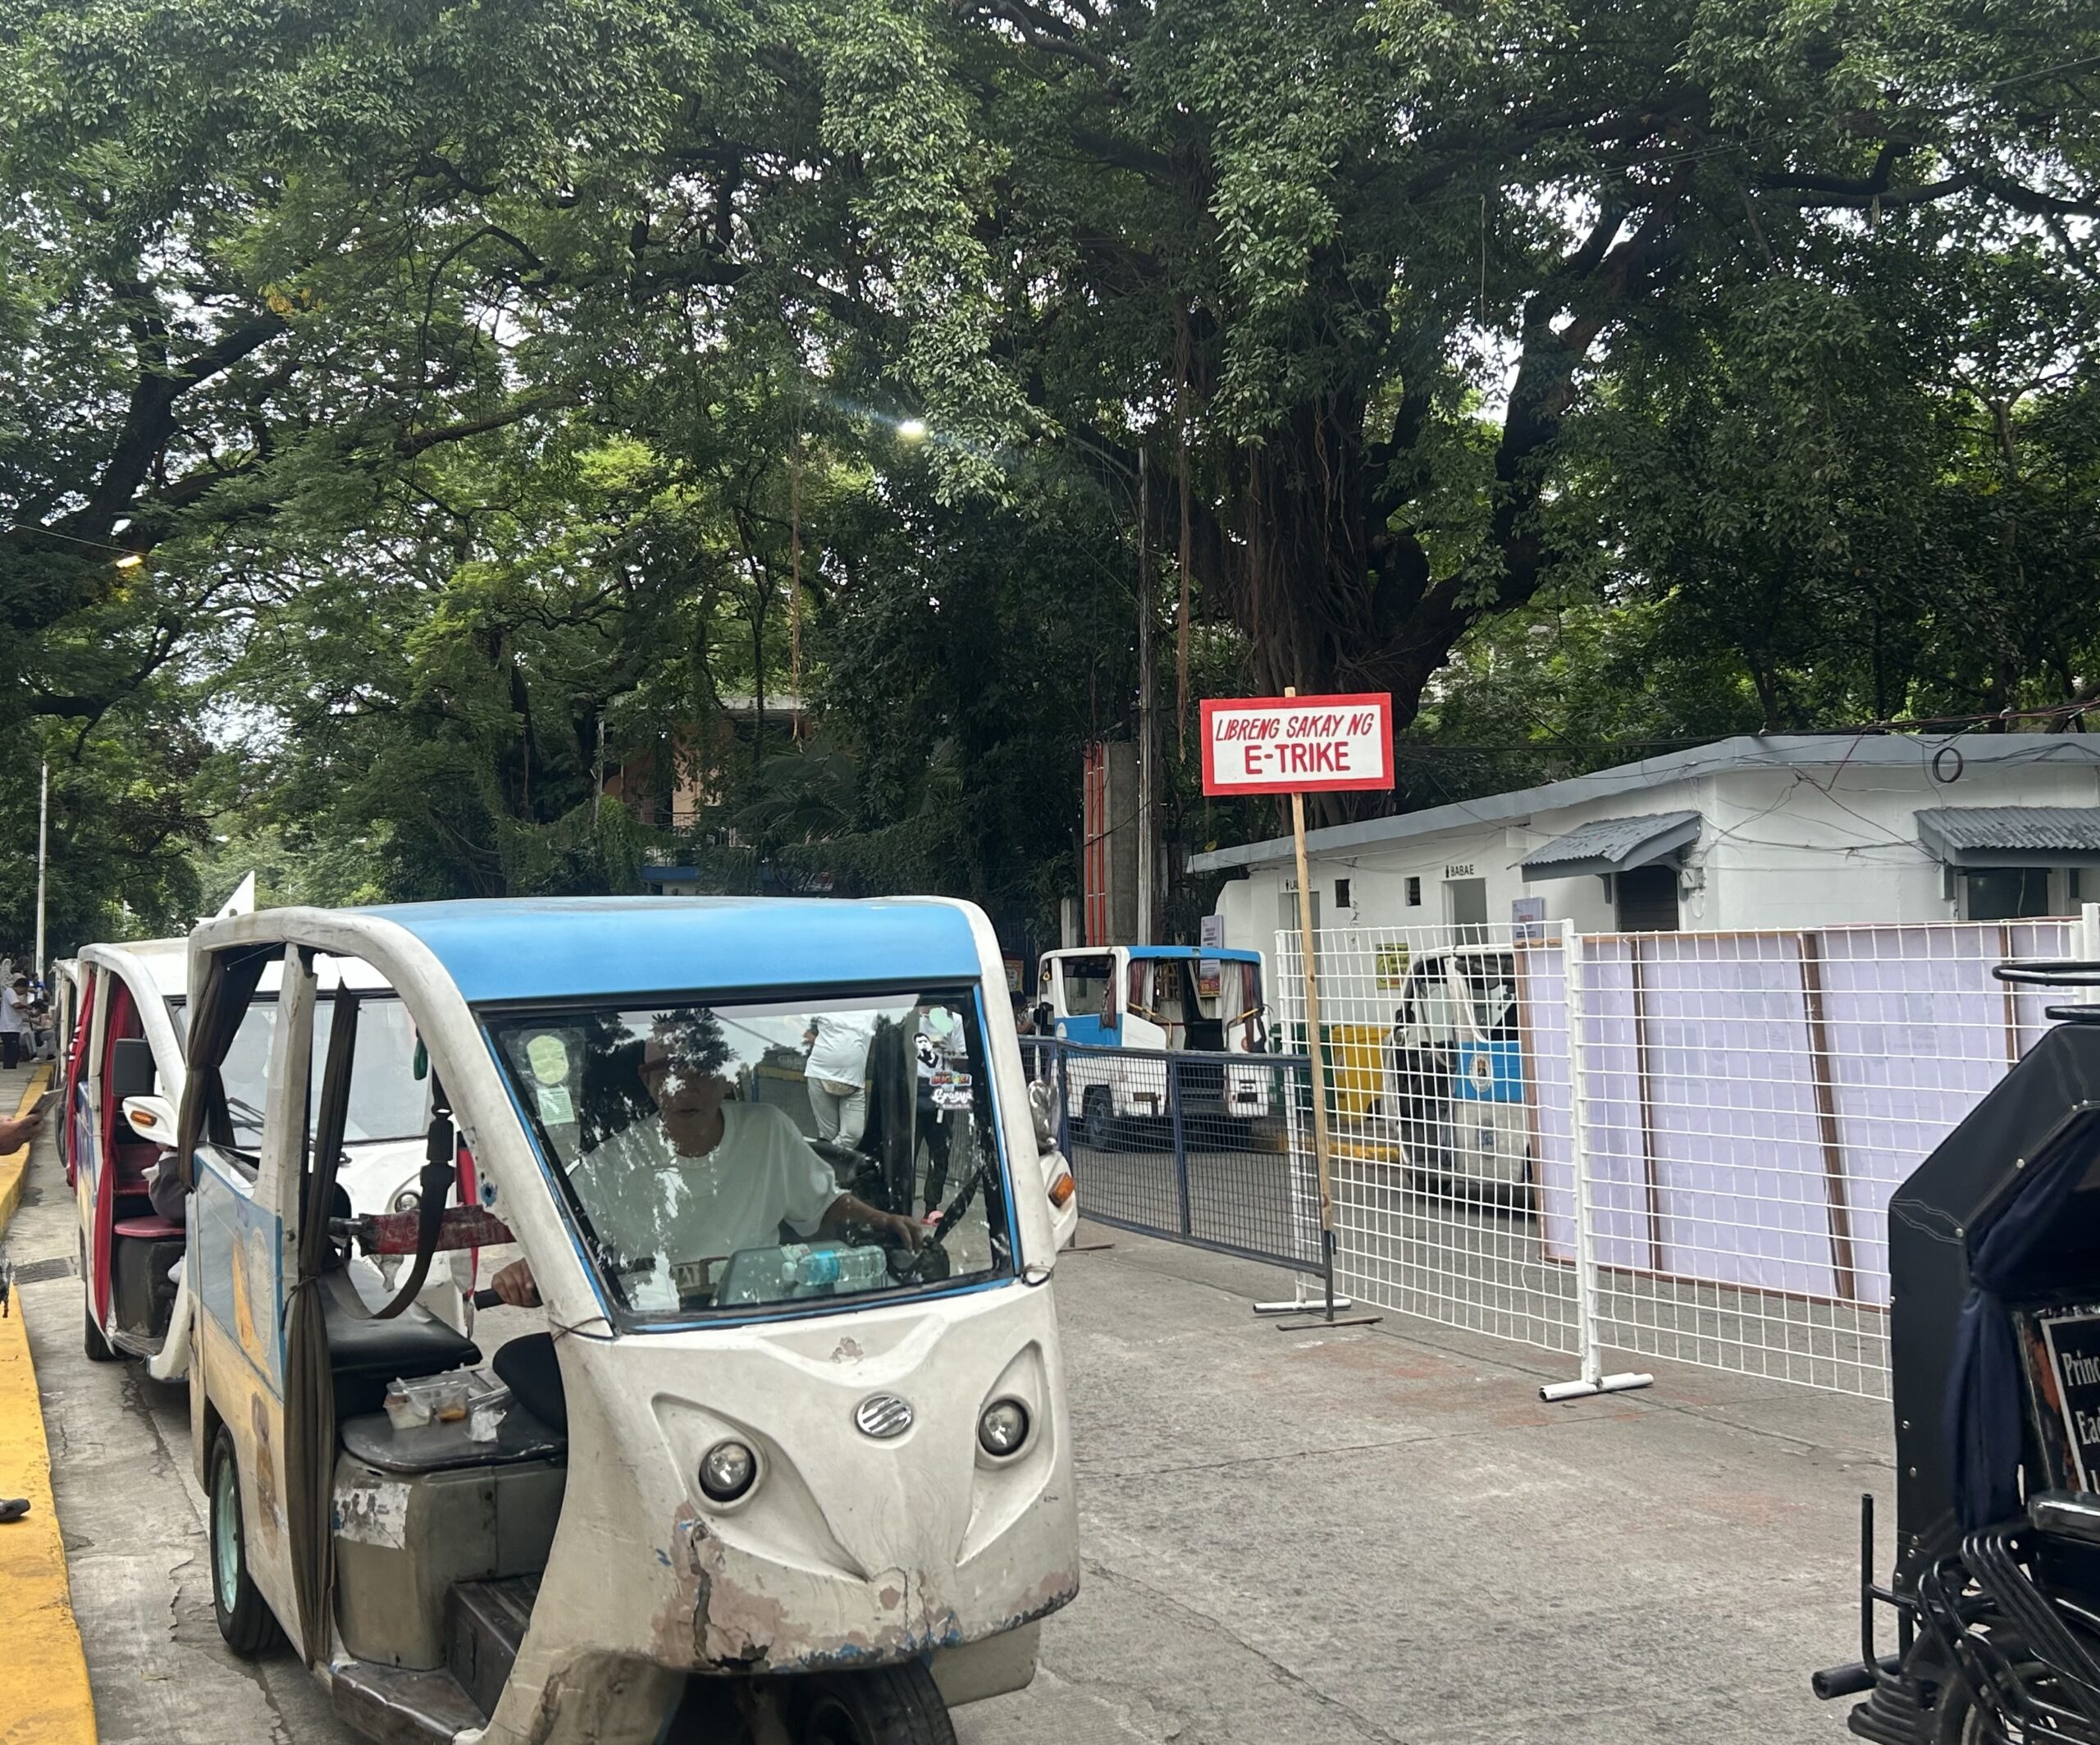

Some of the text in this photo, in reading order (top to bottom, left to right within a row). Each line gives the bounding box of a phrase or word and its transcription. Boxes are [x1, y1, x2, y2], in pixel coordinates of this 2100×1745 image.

[1215, 713, 1374, 741] LIBRENG SAKAY NG
[1244, 742, 1351, 774] E-TRIKE
[1450, 864, 1474, 877] BABAE
